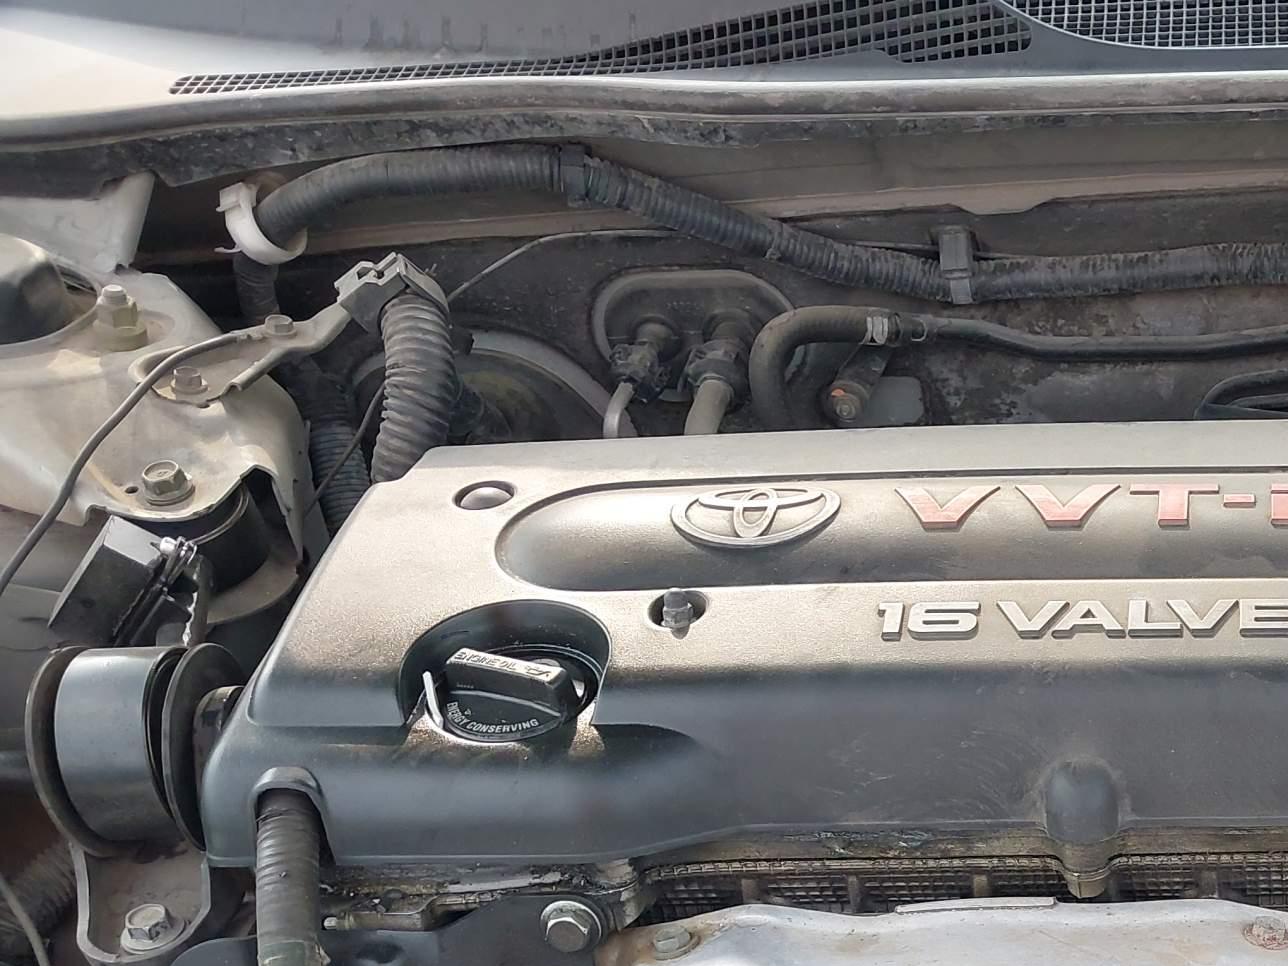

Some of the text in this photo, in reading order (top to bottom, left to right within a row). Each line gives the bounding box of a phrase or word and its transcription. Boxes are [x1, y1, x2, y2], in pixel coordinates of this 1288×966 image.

[878, 601, 981, 642] 16
[453, 651, 500, 667] ENGINE
[446, 701, 540, 734] ENERGY CONSERVING
